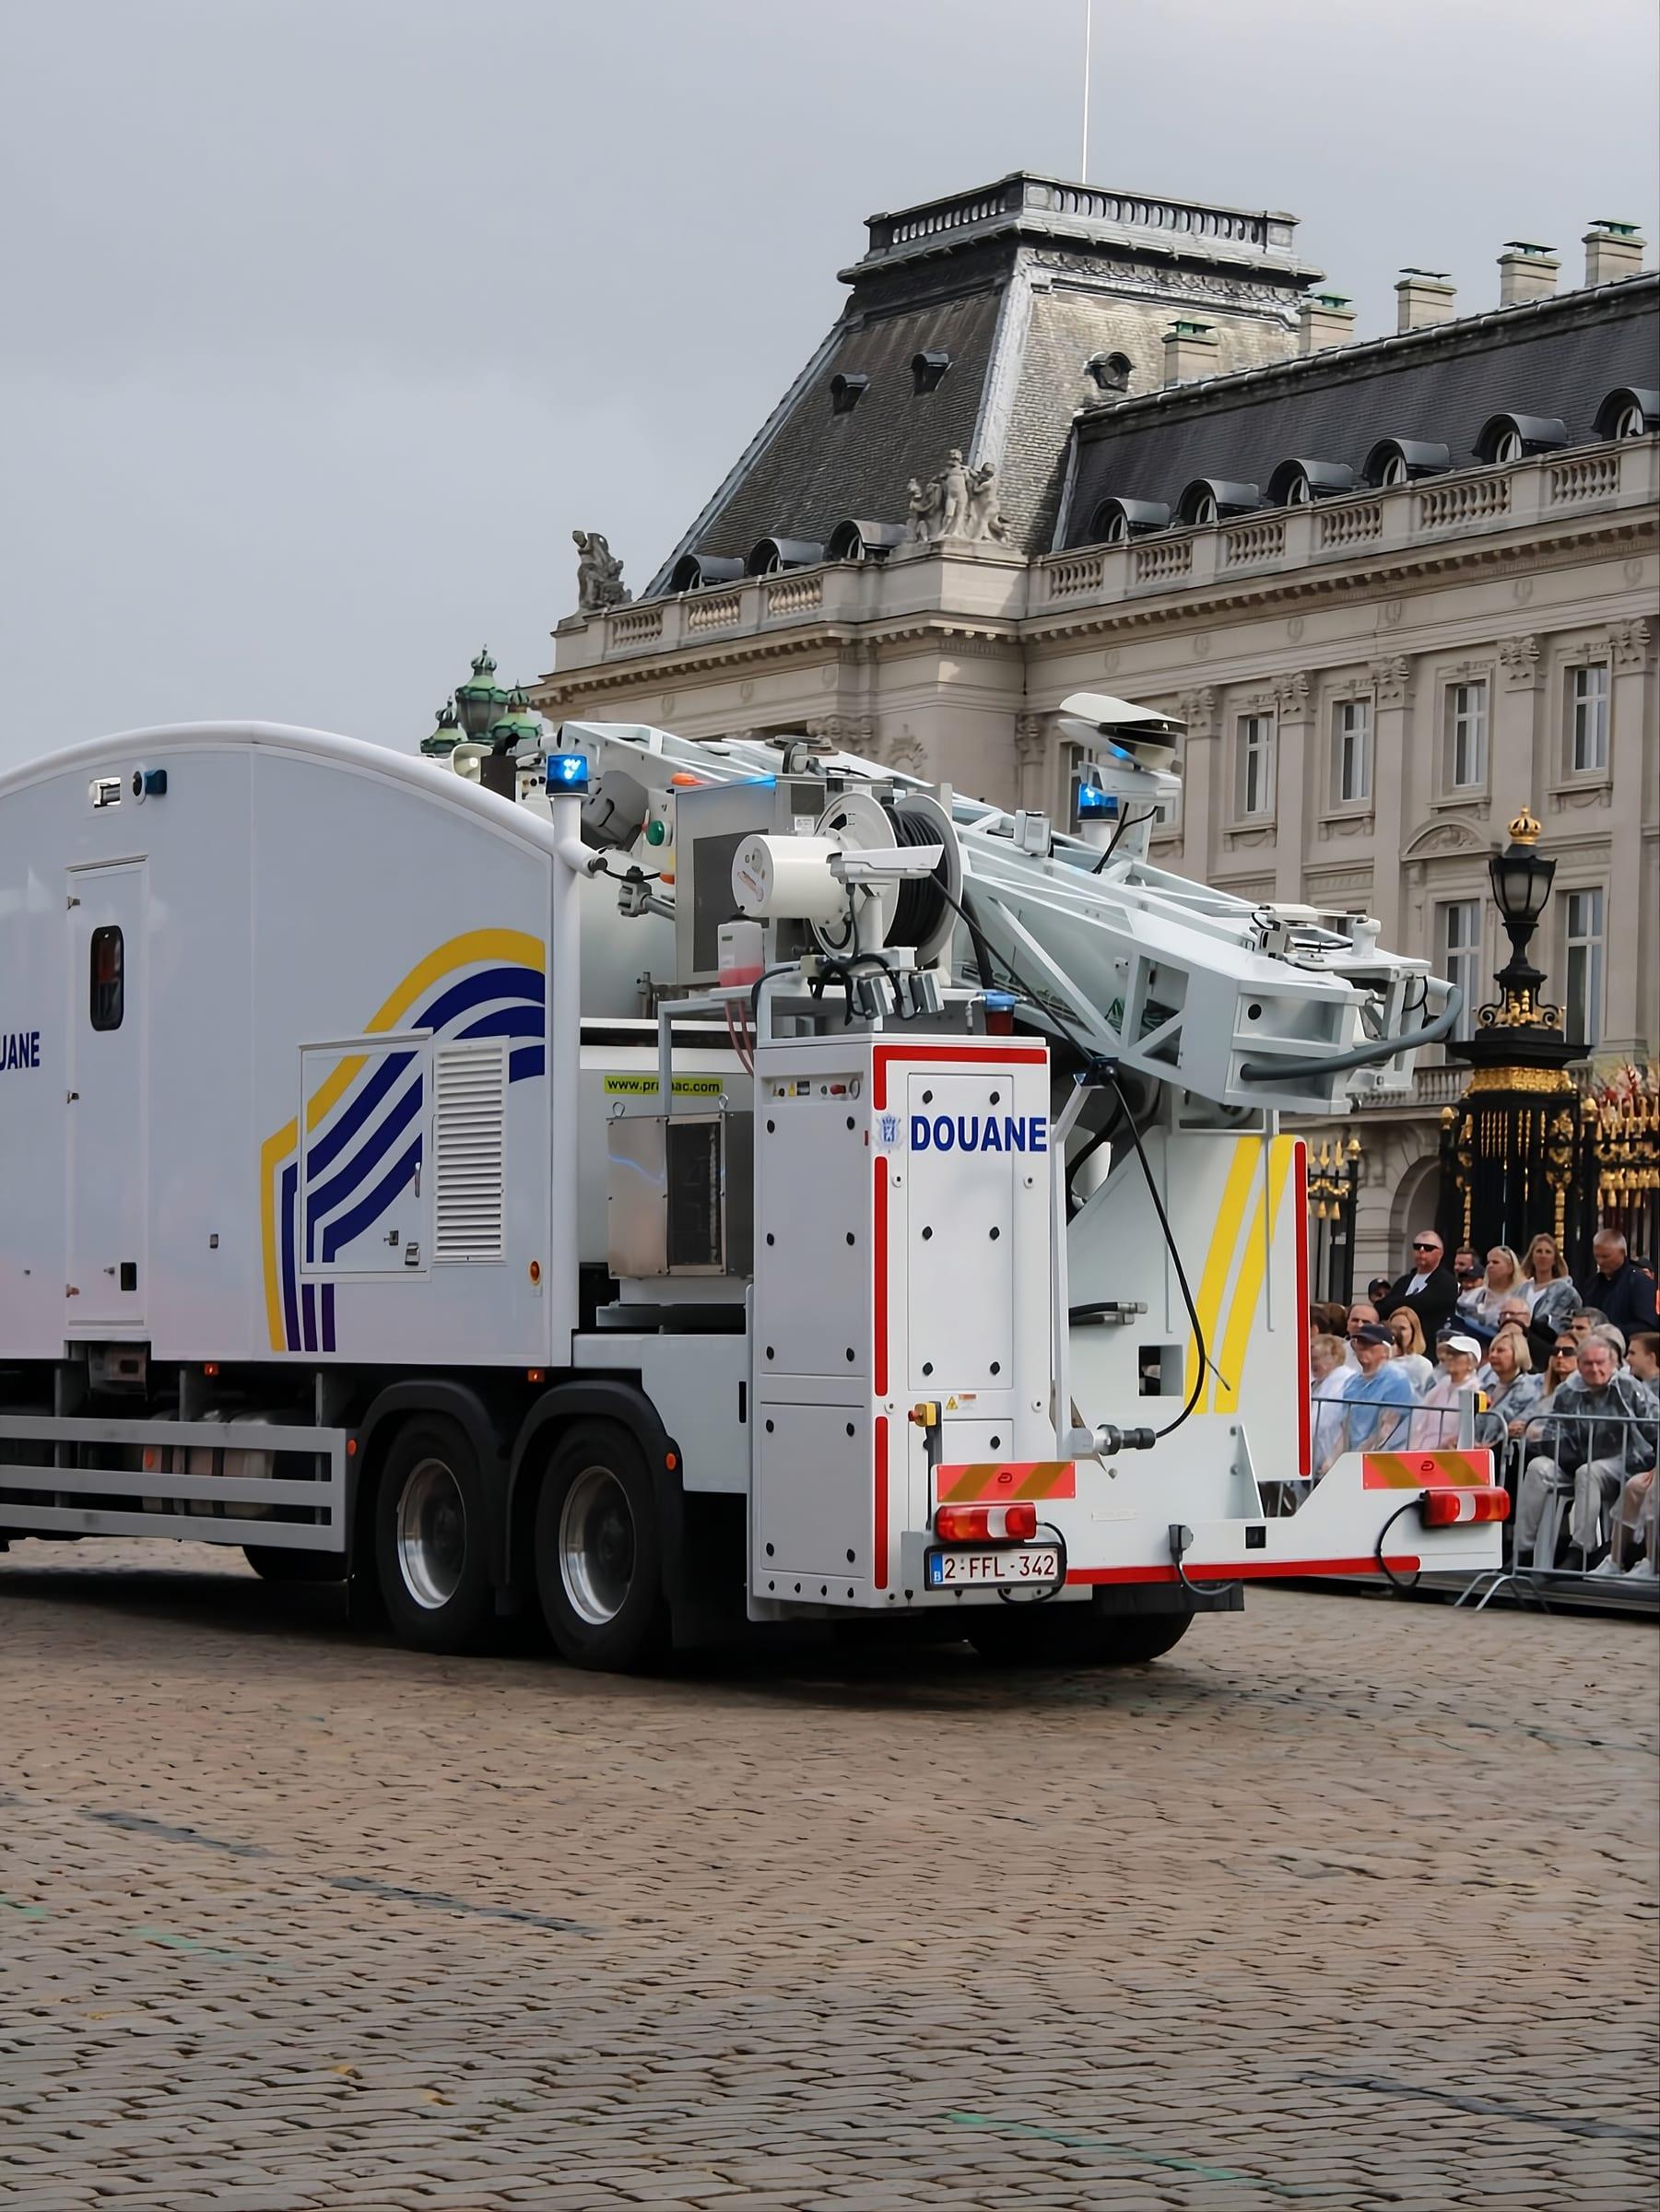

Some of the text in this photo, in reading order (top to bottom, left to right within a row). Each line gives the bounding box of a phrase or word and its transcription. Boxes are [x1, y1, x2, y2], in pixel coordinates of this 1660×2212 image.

[608, 1080, 720, 1093] www.prac.com
[911, 1115, 1048, 1152] DOUANE
[945, 1555, 1055, 1579] 2-FFL-342
[934, 1571, 941, 1582] B
